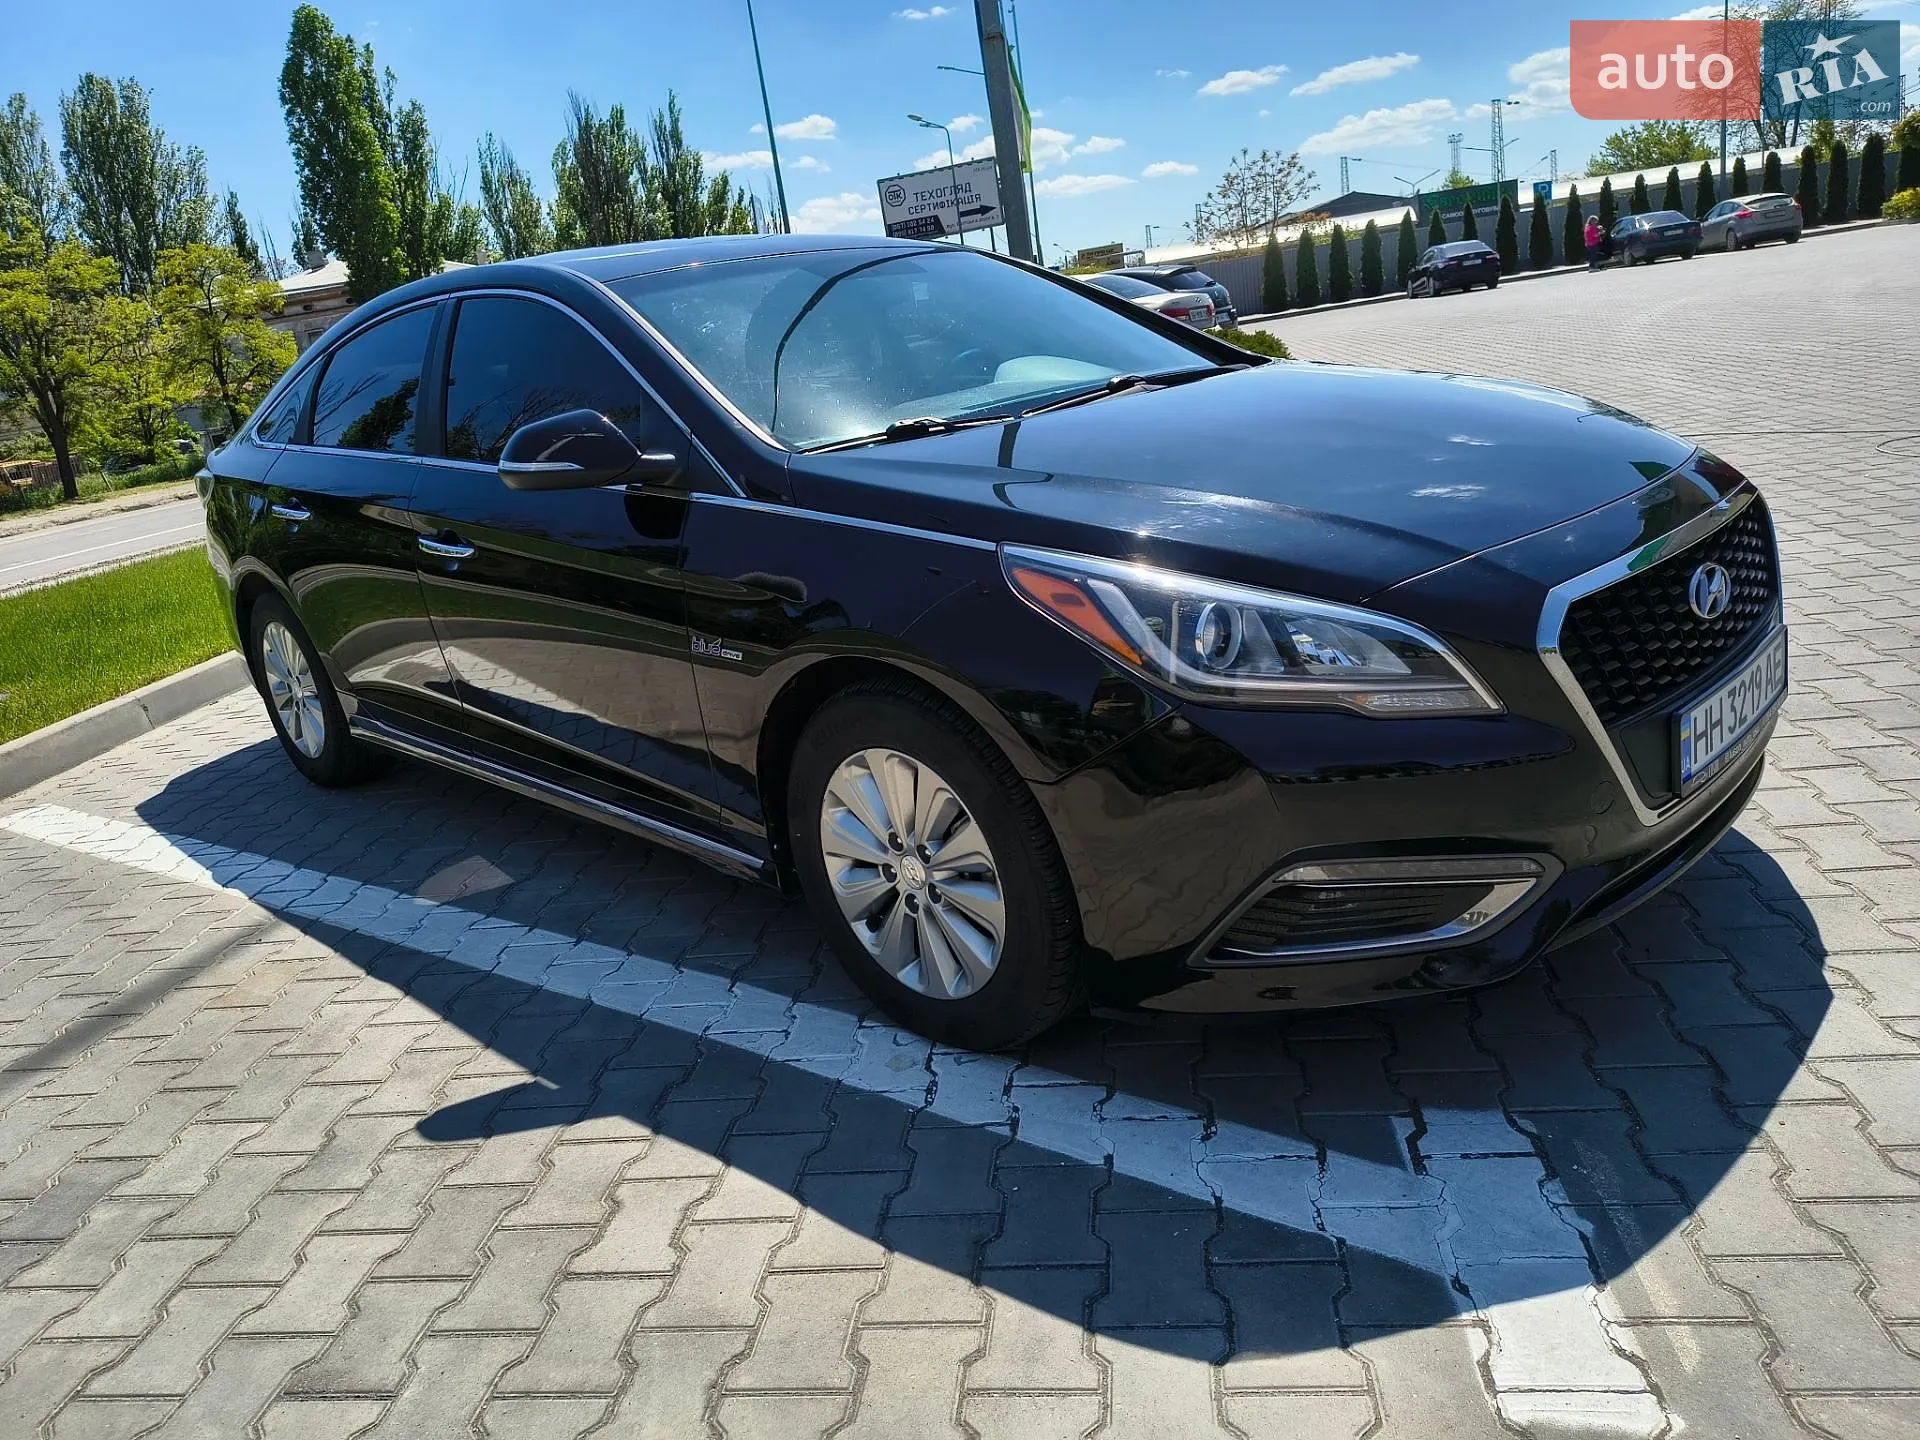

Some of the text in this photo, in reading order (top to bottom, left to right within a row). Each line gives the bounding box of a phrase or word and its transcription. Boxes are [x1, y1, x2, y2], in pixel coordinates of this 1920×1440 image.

[912, 182, 973, 203] ТЕХОГЛЯД
[908, 193, 982, 216] СЕРТИФІКАЦІЯ
[691, 635, 721, 656] blue
[1693, 696, 1724, 764] HH
[1728, 663, 1761, 735] 3219
[1765, 642, 1783, 701] AE
